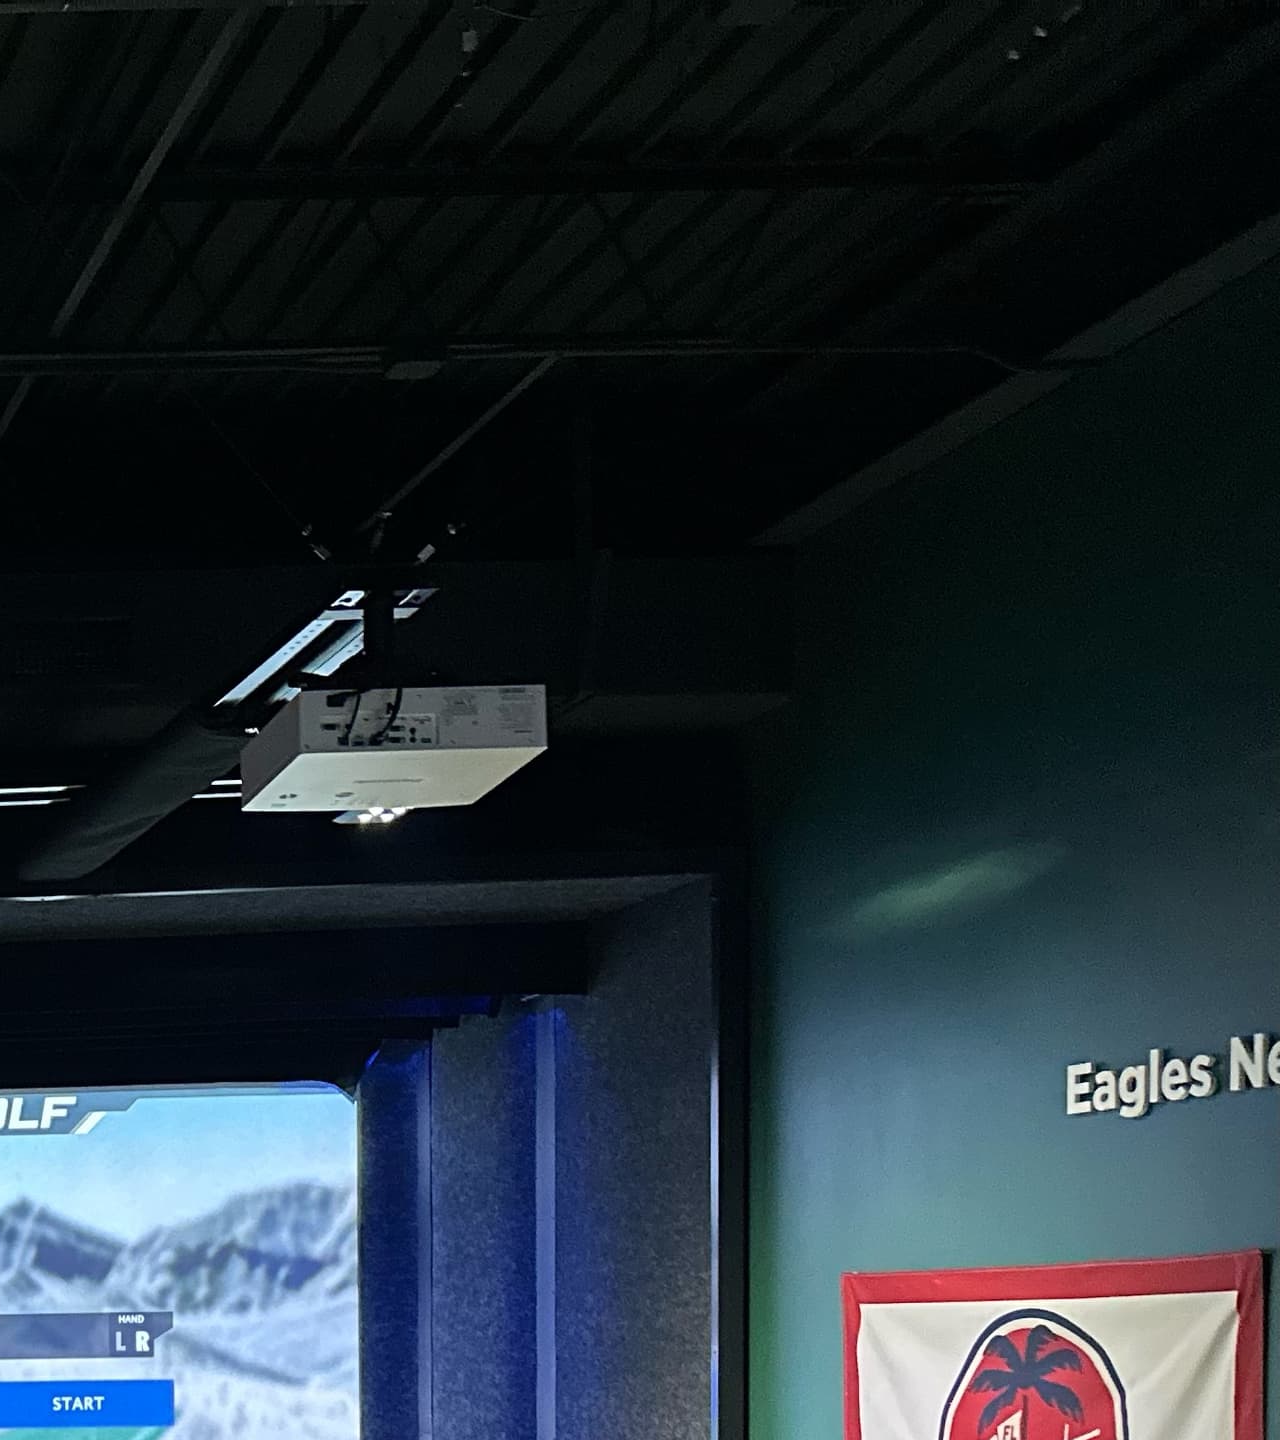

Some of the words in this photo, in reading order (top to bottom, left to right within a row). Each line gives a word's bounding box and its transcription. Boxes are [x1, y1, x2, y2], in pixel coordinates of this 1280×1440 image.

[1066, 1049, 1216, 1118] Eagles
[118, 1314, 145, 1324] HAND
[115, 1331, 126, 1352] L
[135, 1330, 150, 1352] R
[52, 1396, 105, 1411] START
